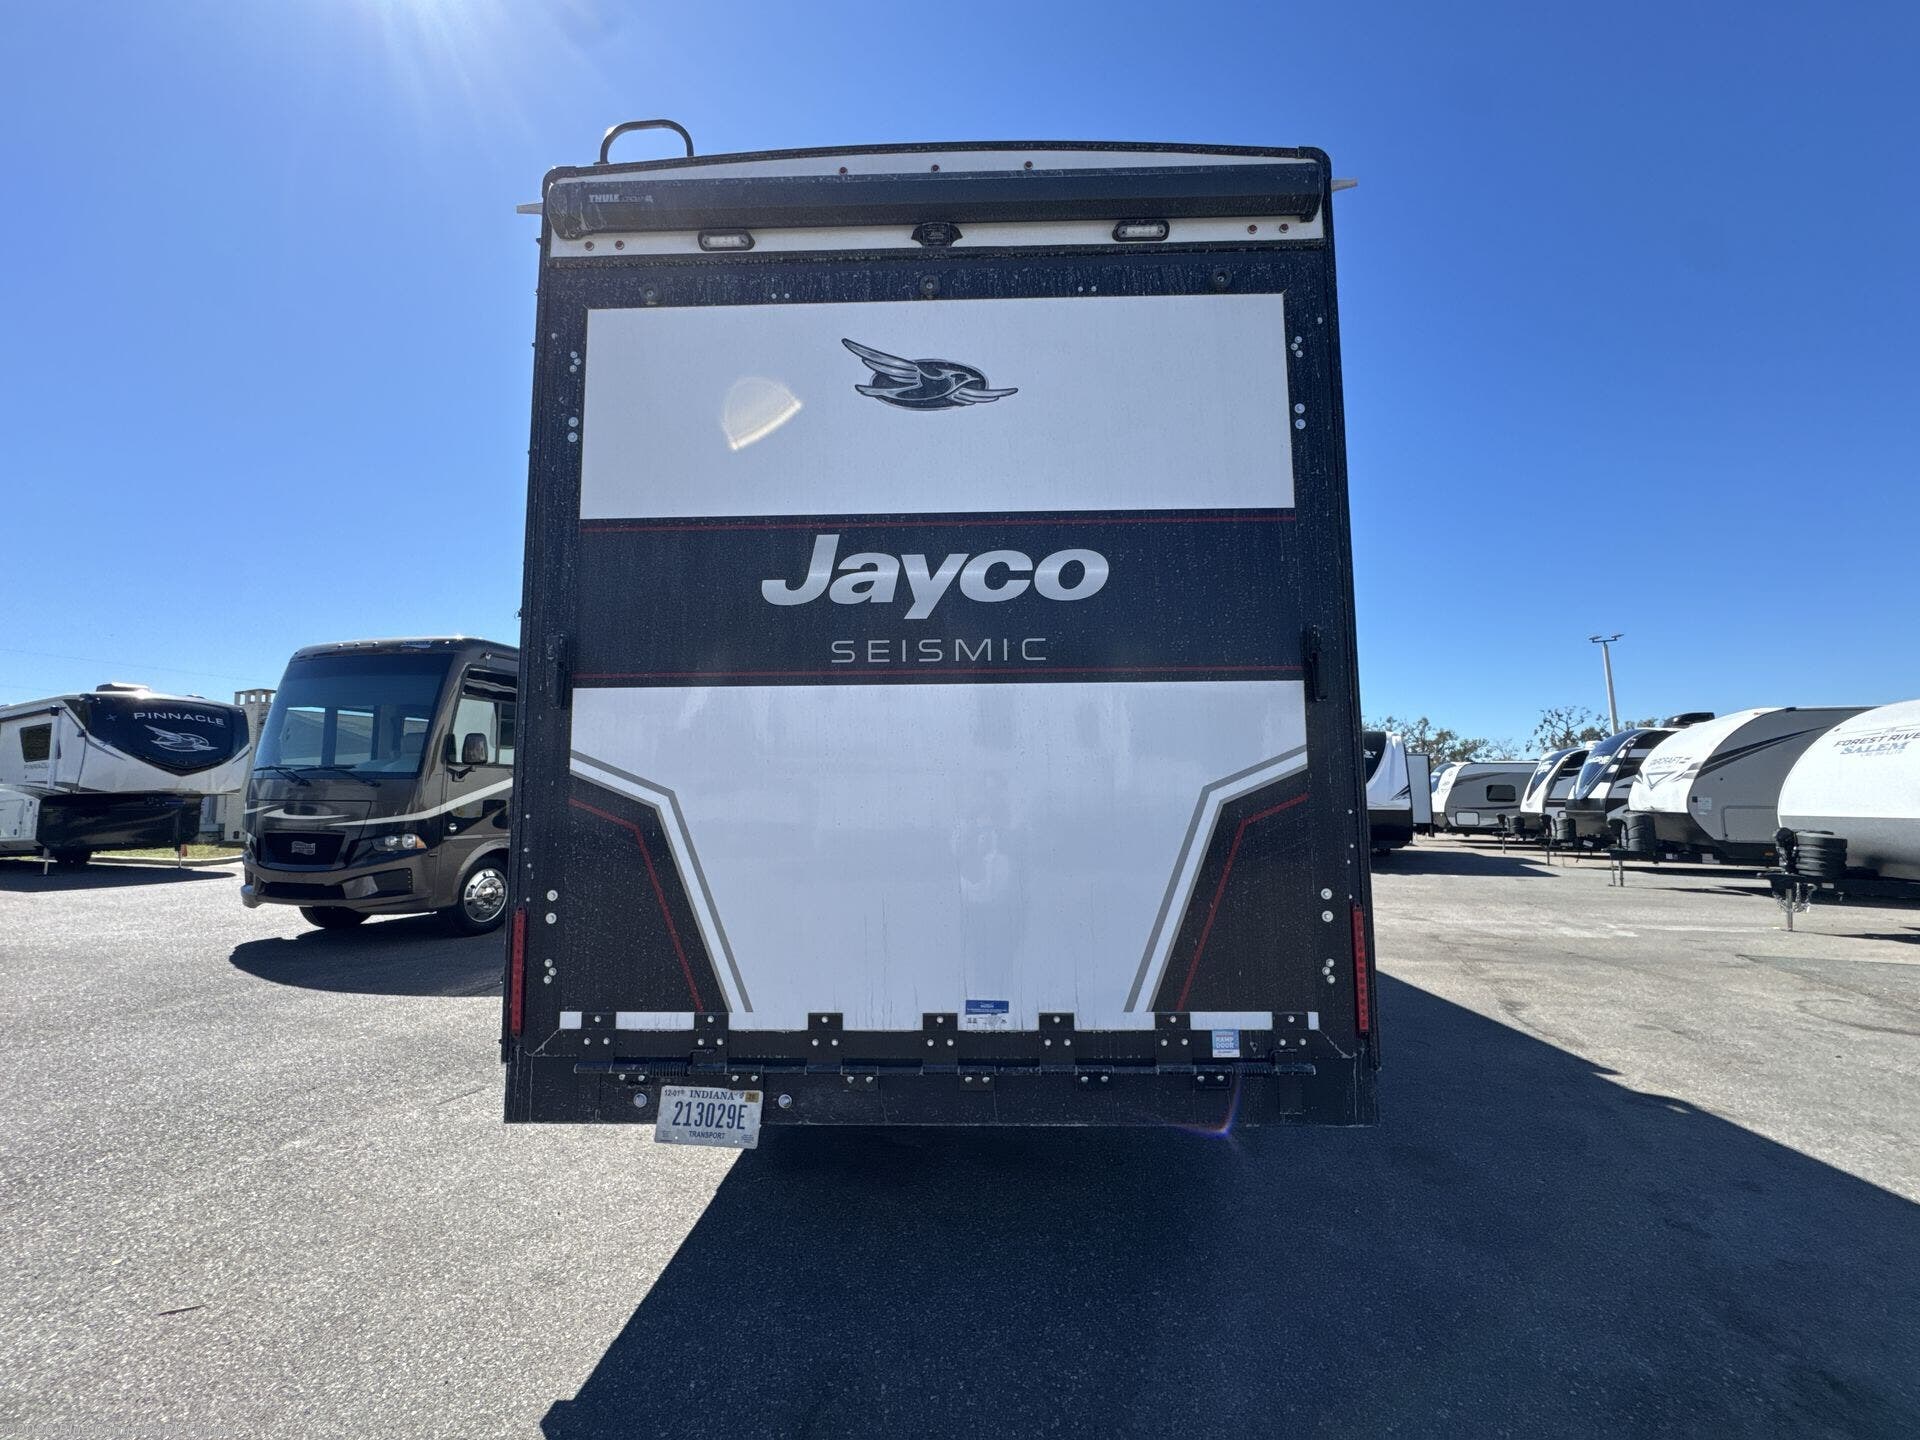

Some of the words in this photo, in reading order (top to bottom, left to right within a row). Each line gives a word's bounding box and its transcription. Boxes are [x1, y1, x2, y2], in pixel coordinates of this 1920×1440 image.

[588, 193, 620, 203] THULE
[761, 534, 1109, 620] Jayco
[830, 637, 1049, 664] SEISMIC
[132, 711, 226, 727] PINNACLE
[1833, 735, 1888, 747] FOREST
[1888, 732, 1920, 742] RIVE
[1840, 741, 1911, 754] SALEM
[689, 1089, 735, 1101] INDIANA
[672, 1101, 748, 1130] 213029E
[688, 1130, 726, 1140] TRANSPORT
